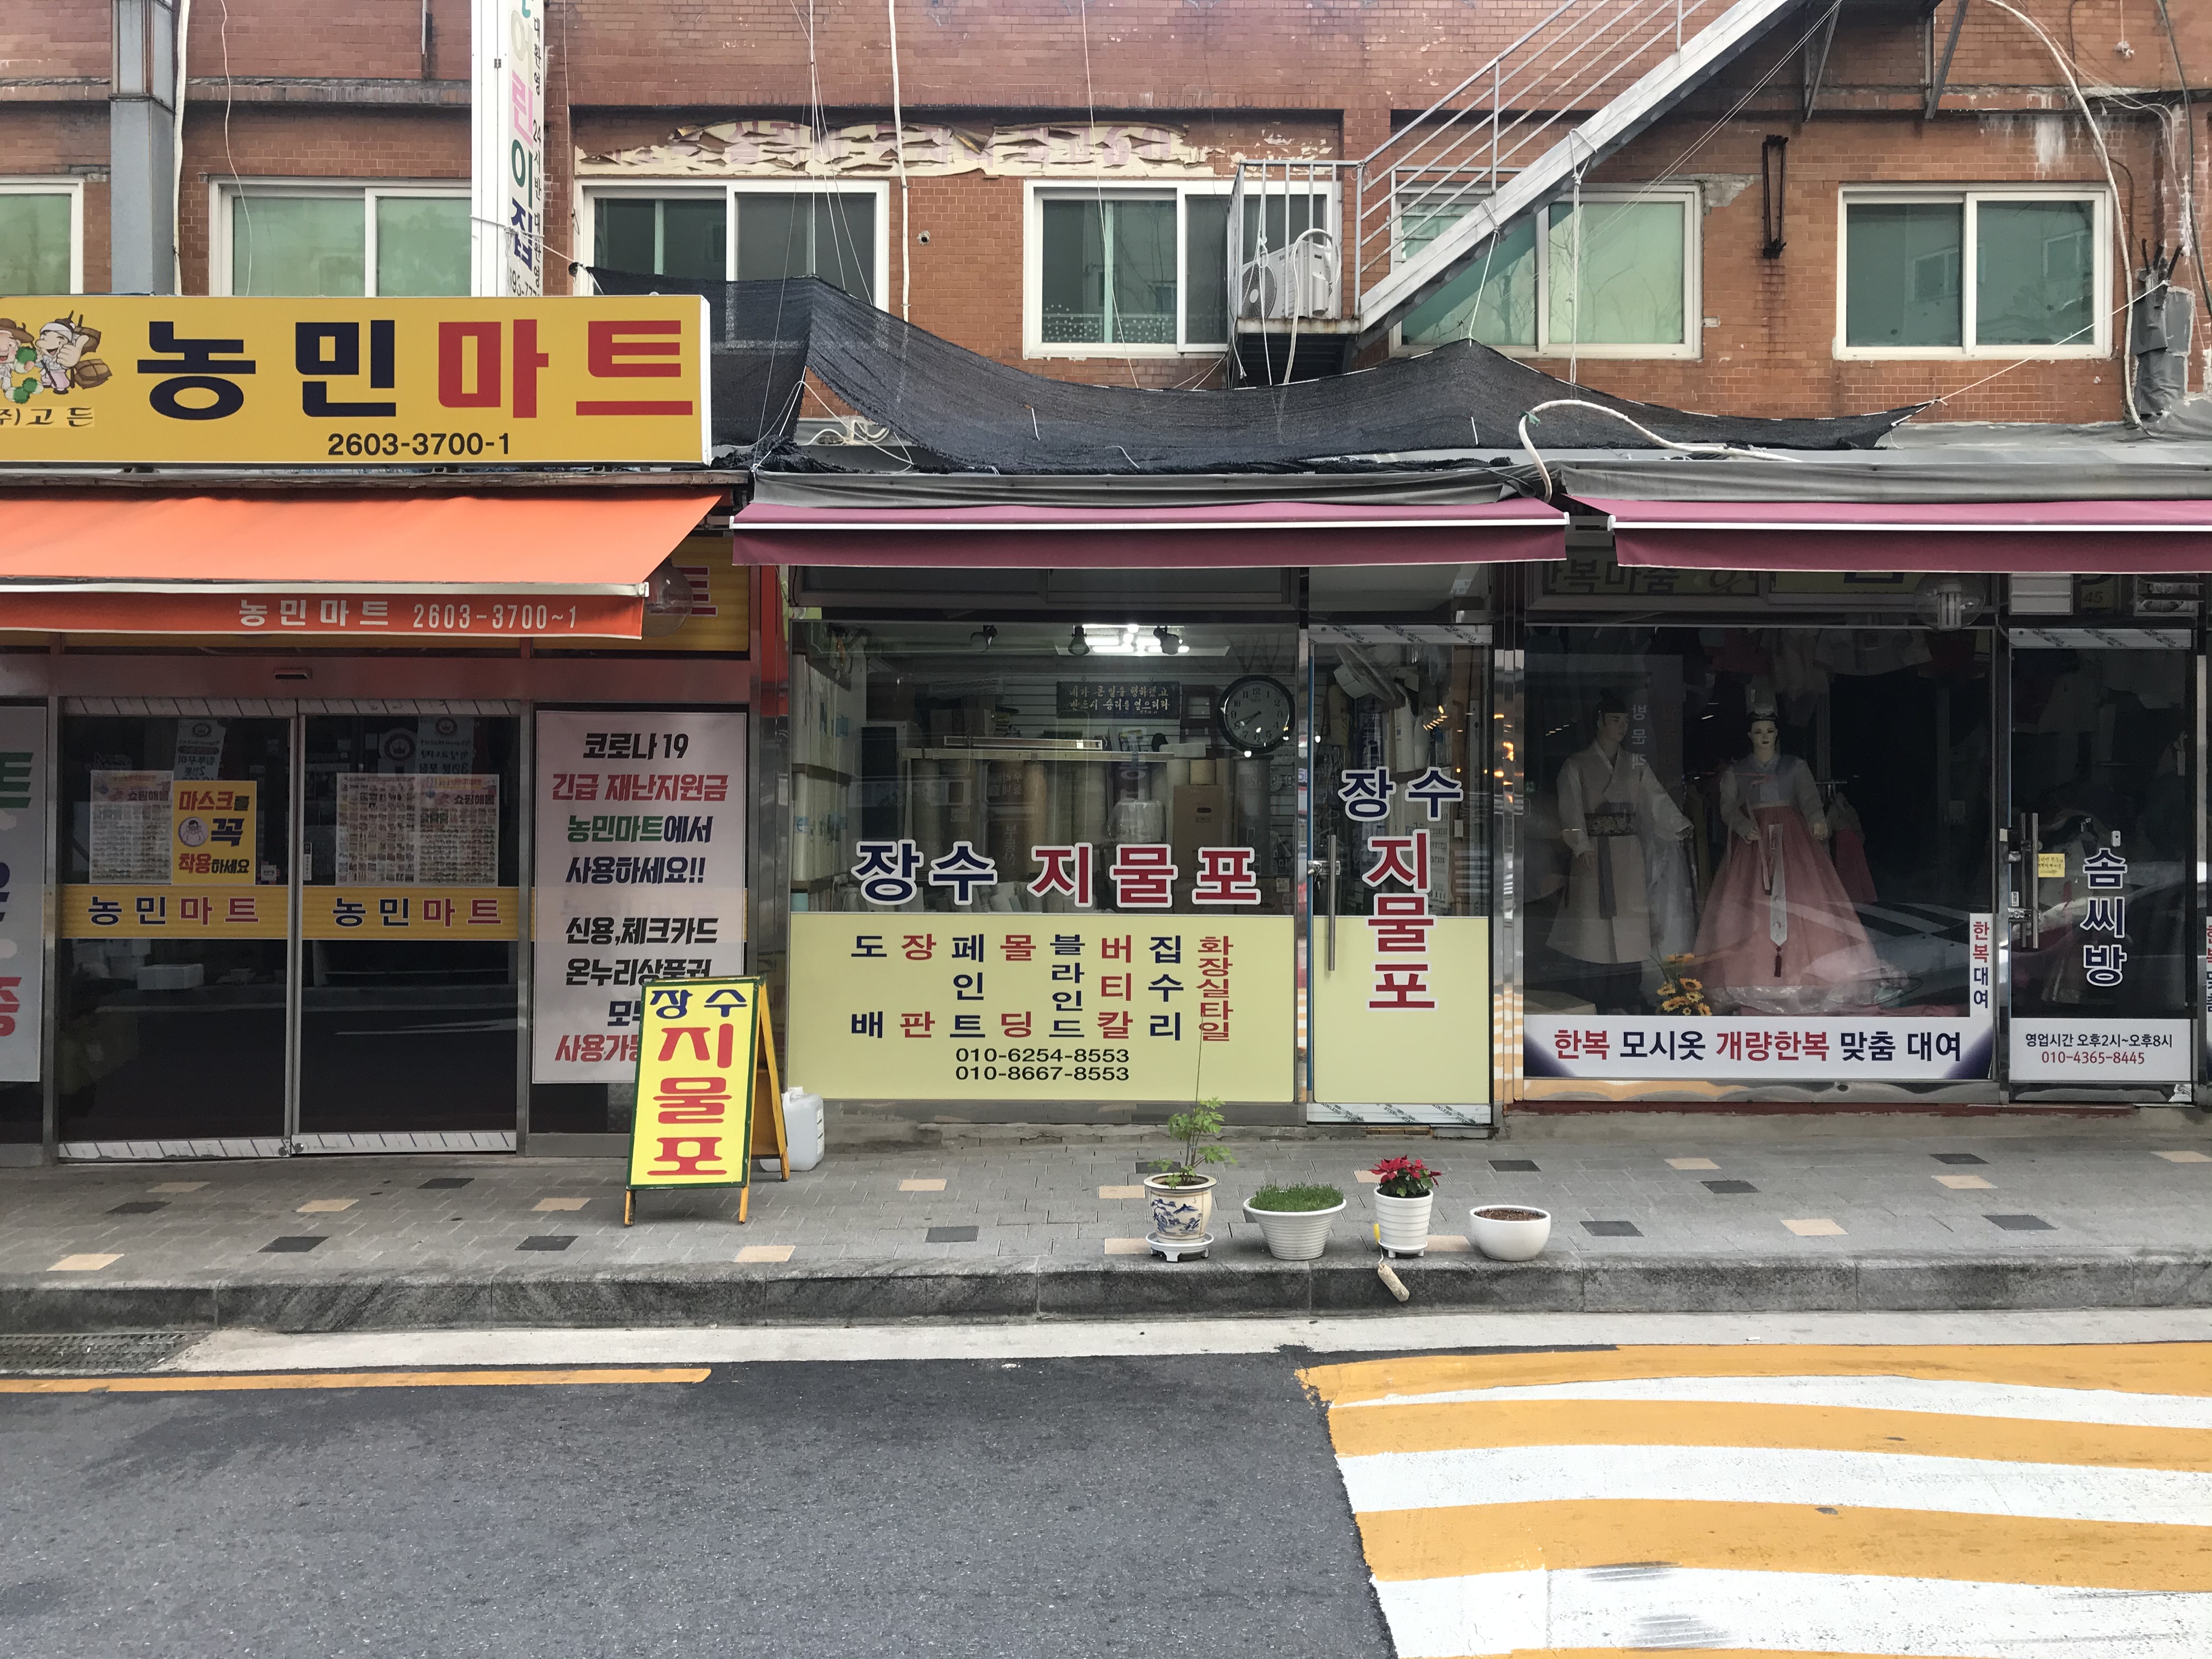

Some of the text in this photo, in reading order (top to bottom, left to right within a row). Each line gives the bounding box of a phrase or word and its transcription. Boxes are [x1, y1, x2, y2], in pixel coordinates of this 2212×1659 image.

[510, 0, 533, 272] 어린이집
[137, 319, 693, 420] 농민마트
[328, 432, 510, 456] 2603-3700-1
[239, 598, 577, 630] 농민마트 2603-3700~1
[583, 733, 689, 760] 코로나 19
[552, 774, 729, 802] 긴급 재난지원금
[1339, 766, 1464, 821] 장수
[211, 818, 245, 847] 꼭
[567, 815, 713, 843] 농민마트에서
[178, 853, 250, 874] 착용하세요
[566, 857, 706, 884] 사용하세요!!
[853, 839, 1261, 908] 장수 지물포
[88, 896, 259, 926] 농민마트
[332, 898, 502, 927] 농민마트
[1362, 829, 1438, 1012] 지물포
[2080, 848, 2128, 987] 솜씨방
[566, 917, 718, 945] 신용,체크카드
[607, 1000, 642, 1026] 모
[650, 989, 747, 1019] 장수
[555, 1034, 639, 1063] 사용가
[956, 1048, 1130, 1063] 010-6254-8553
[1554, 1029, 1961, 1063] 한복 모시옷 개량한복 맞춤 대여
[2025, 1034, 2172, 1048] 영업시간 오후2시~오후8시
[2041, 1051, 2145, 1065] 010-4365-8445
[956, 1065, 1130, 1081] 010-8667-8553
[647, 1024, 734, 1176] 지물포
